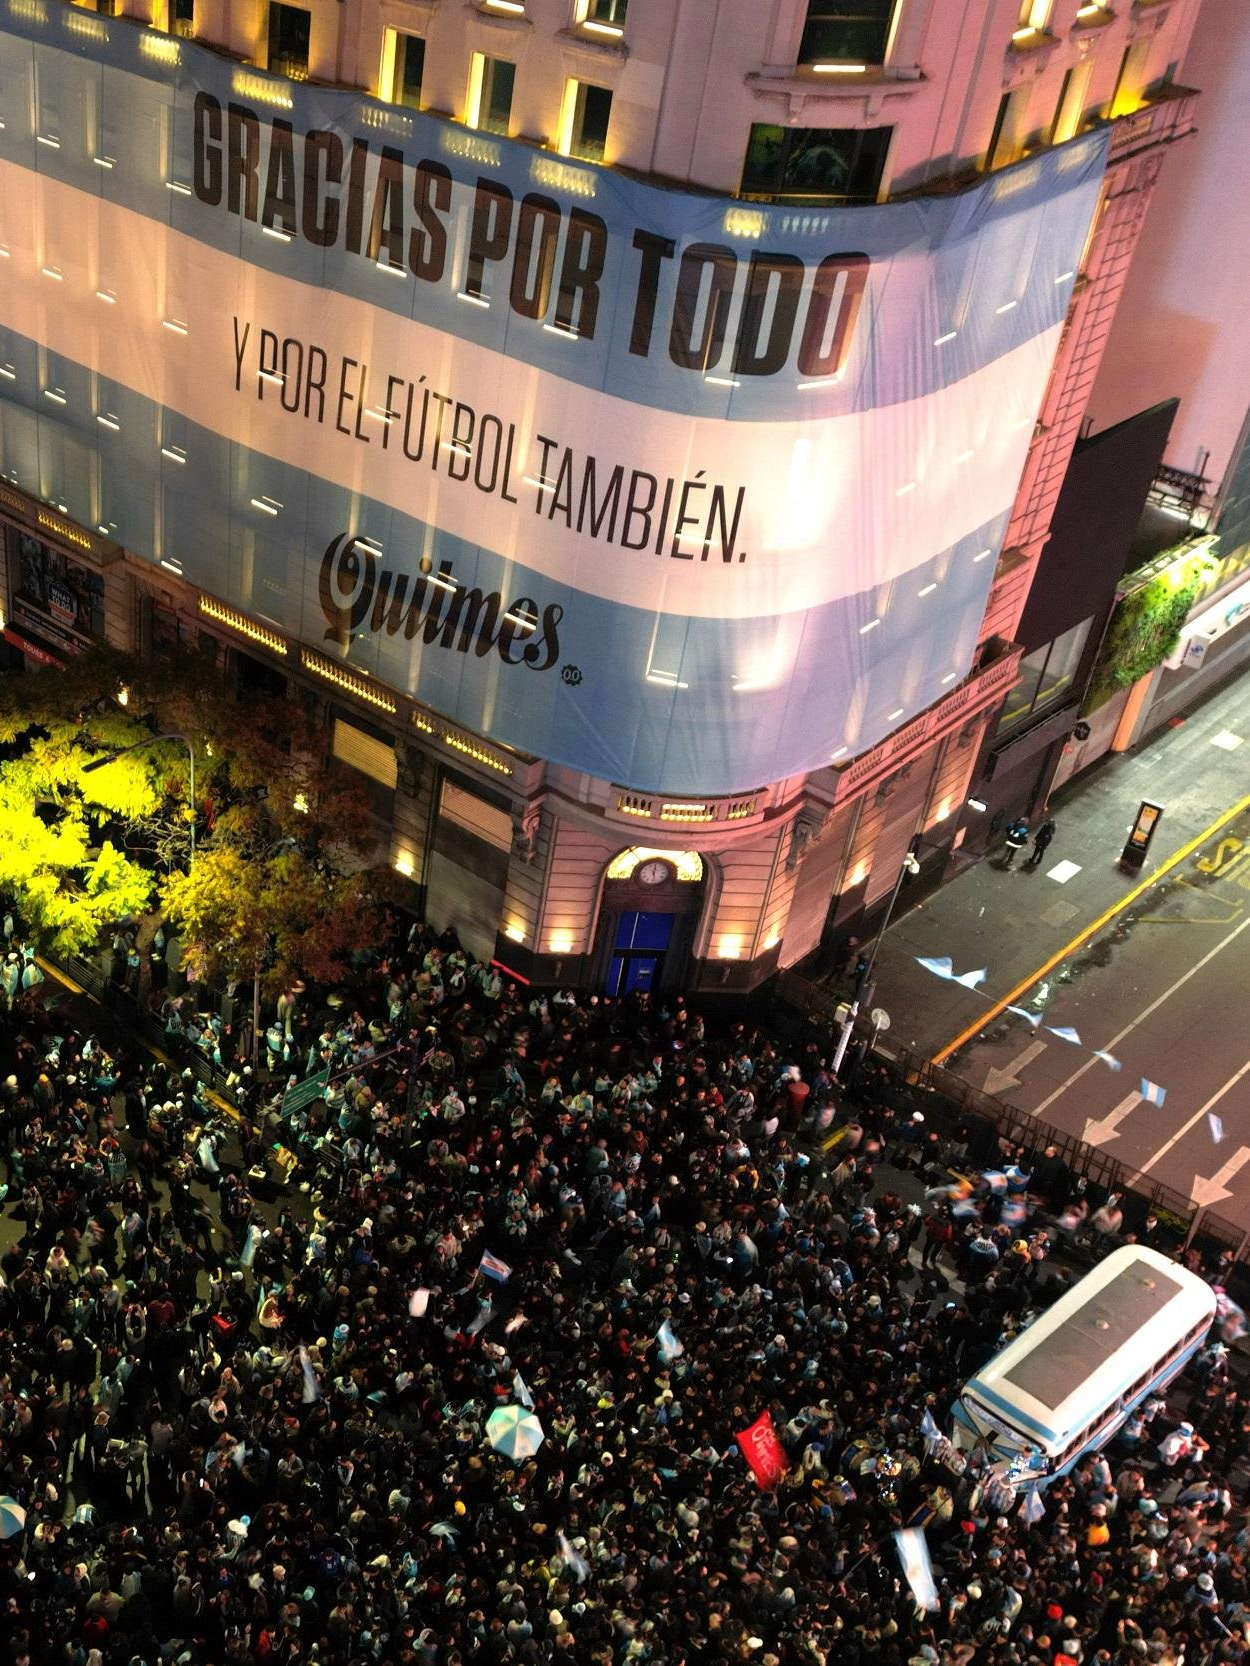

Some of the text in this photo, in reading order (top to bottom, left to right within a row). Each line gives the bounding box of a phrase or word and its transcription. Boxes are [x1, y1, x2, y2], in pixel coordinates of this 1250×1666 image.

[193, 91, 872, 378] GRACIAS POR TODO
[232, 316, 748, 565] Y POR EL FÚTBOL TAMBIÉN.
[318, 531, 564, 672] Quilmes
